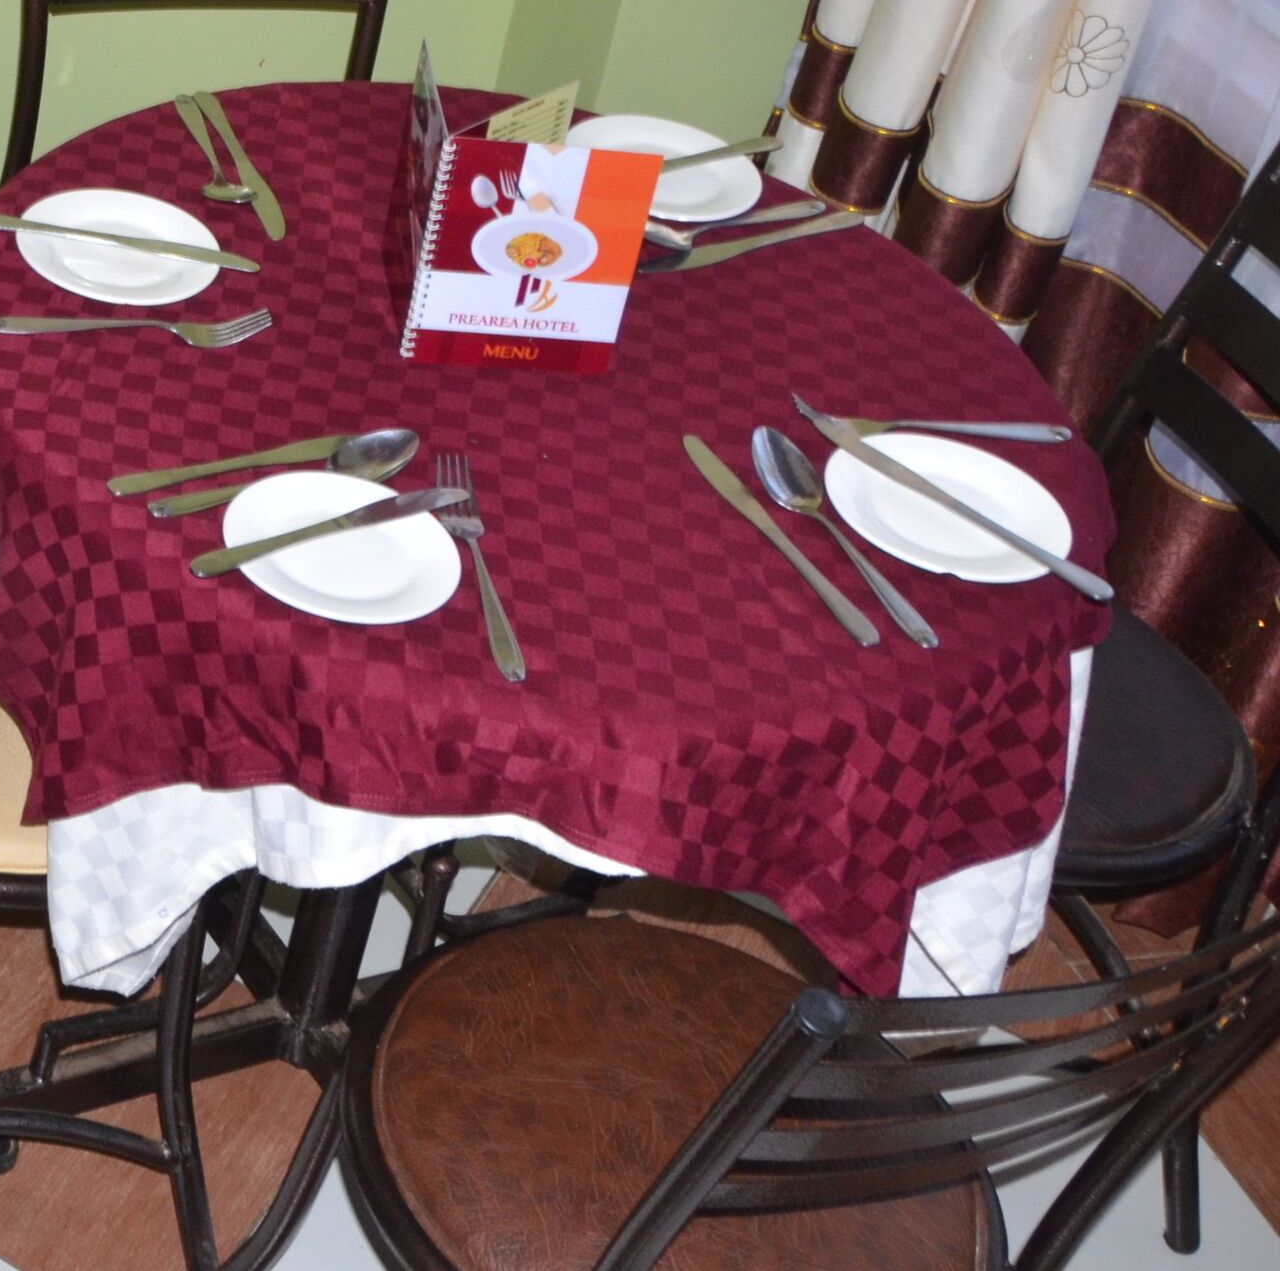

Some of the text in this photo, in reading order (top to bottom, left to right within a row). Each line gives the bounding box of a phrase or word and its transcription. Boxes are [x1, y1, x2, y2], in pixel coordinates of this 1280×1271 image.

[448, 312, 579, 334] PREAREA HOTEL
[483, 344, 539, 360] MENU
